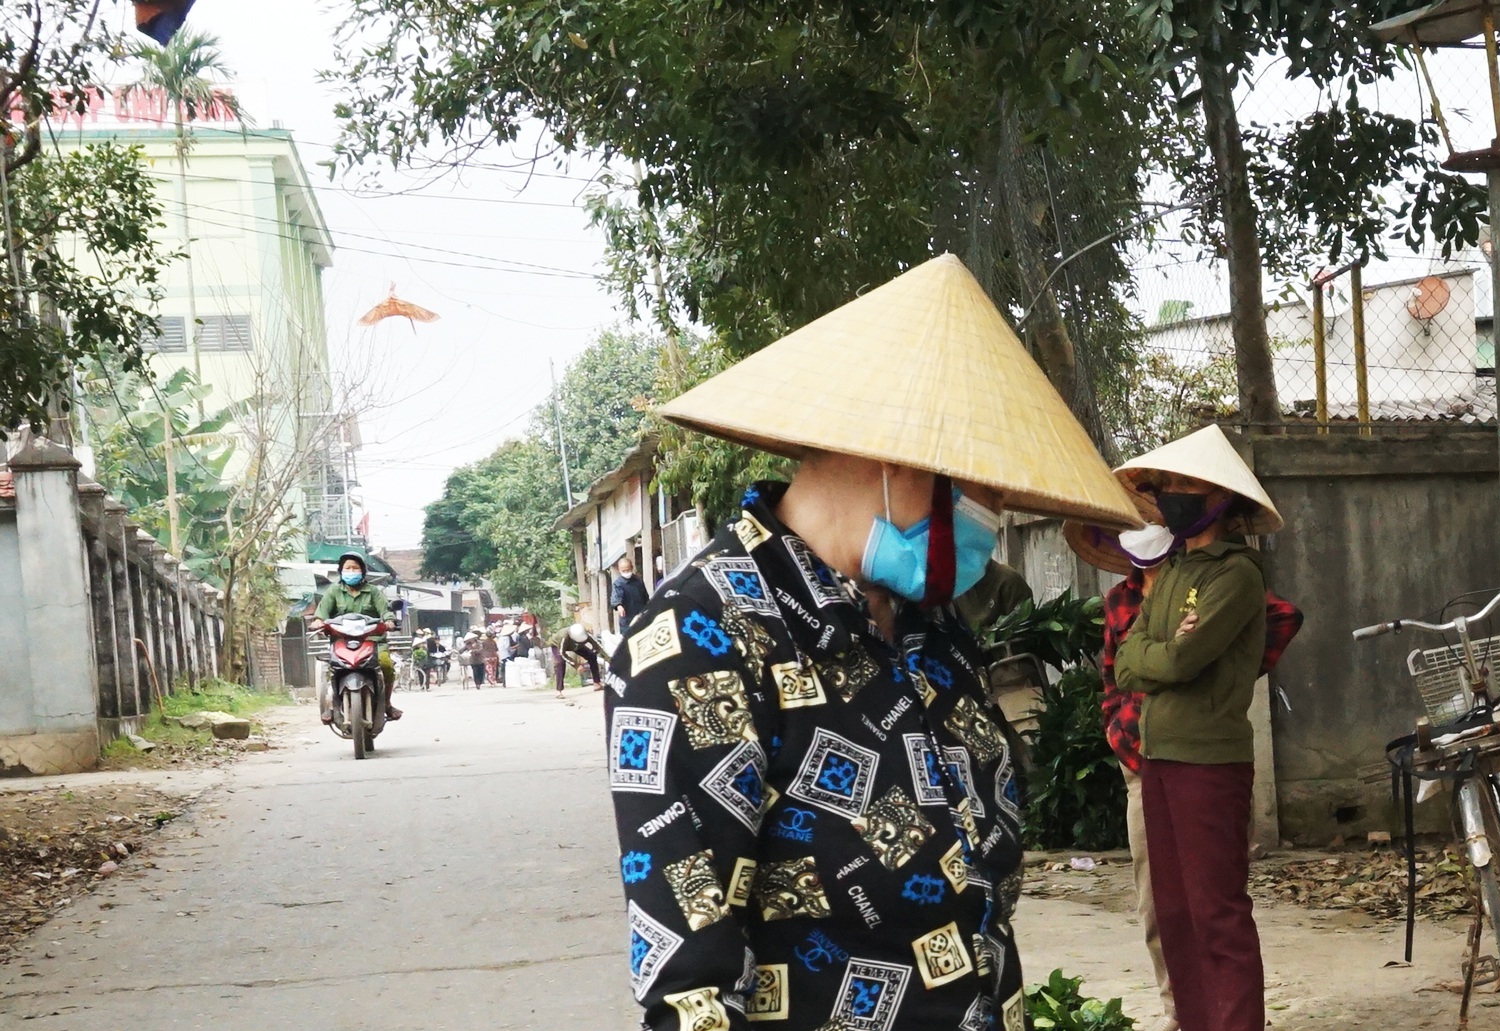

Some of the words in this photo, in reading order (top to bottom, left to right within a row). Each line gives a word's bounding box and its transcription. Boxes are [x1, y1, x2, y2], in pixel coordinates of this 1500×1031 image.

[775, 587, 820, 629] CHANEL
[861, 714, 887, 742] CHANEL
[880, 695, 913, 731] CHANEL
[637, 801, 686, 838] CHANEL
[847, 885, 882, 930] CHANEL
